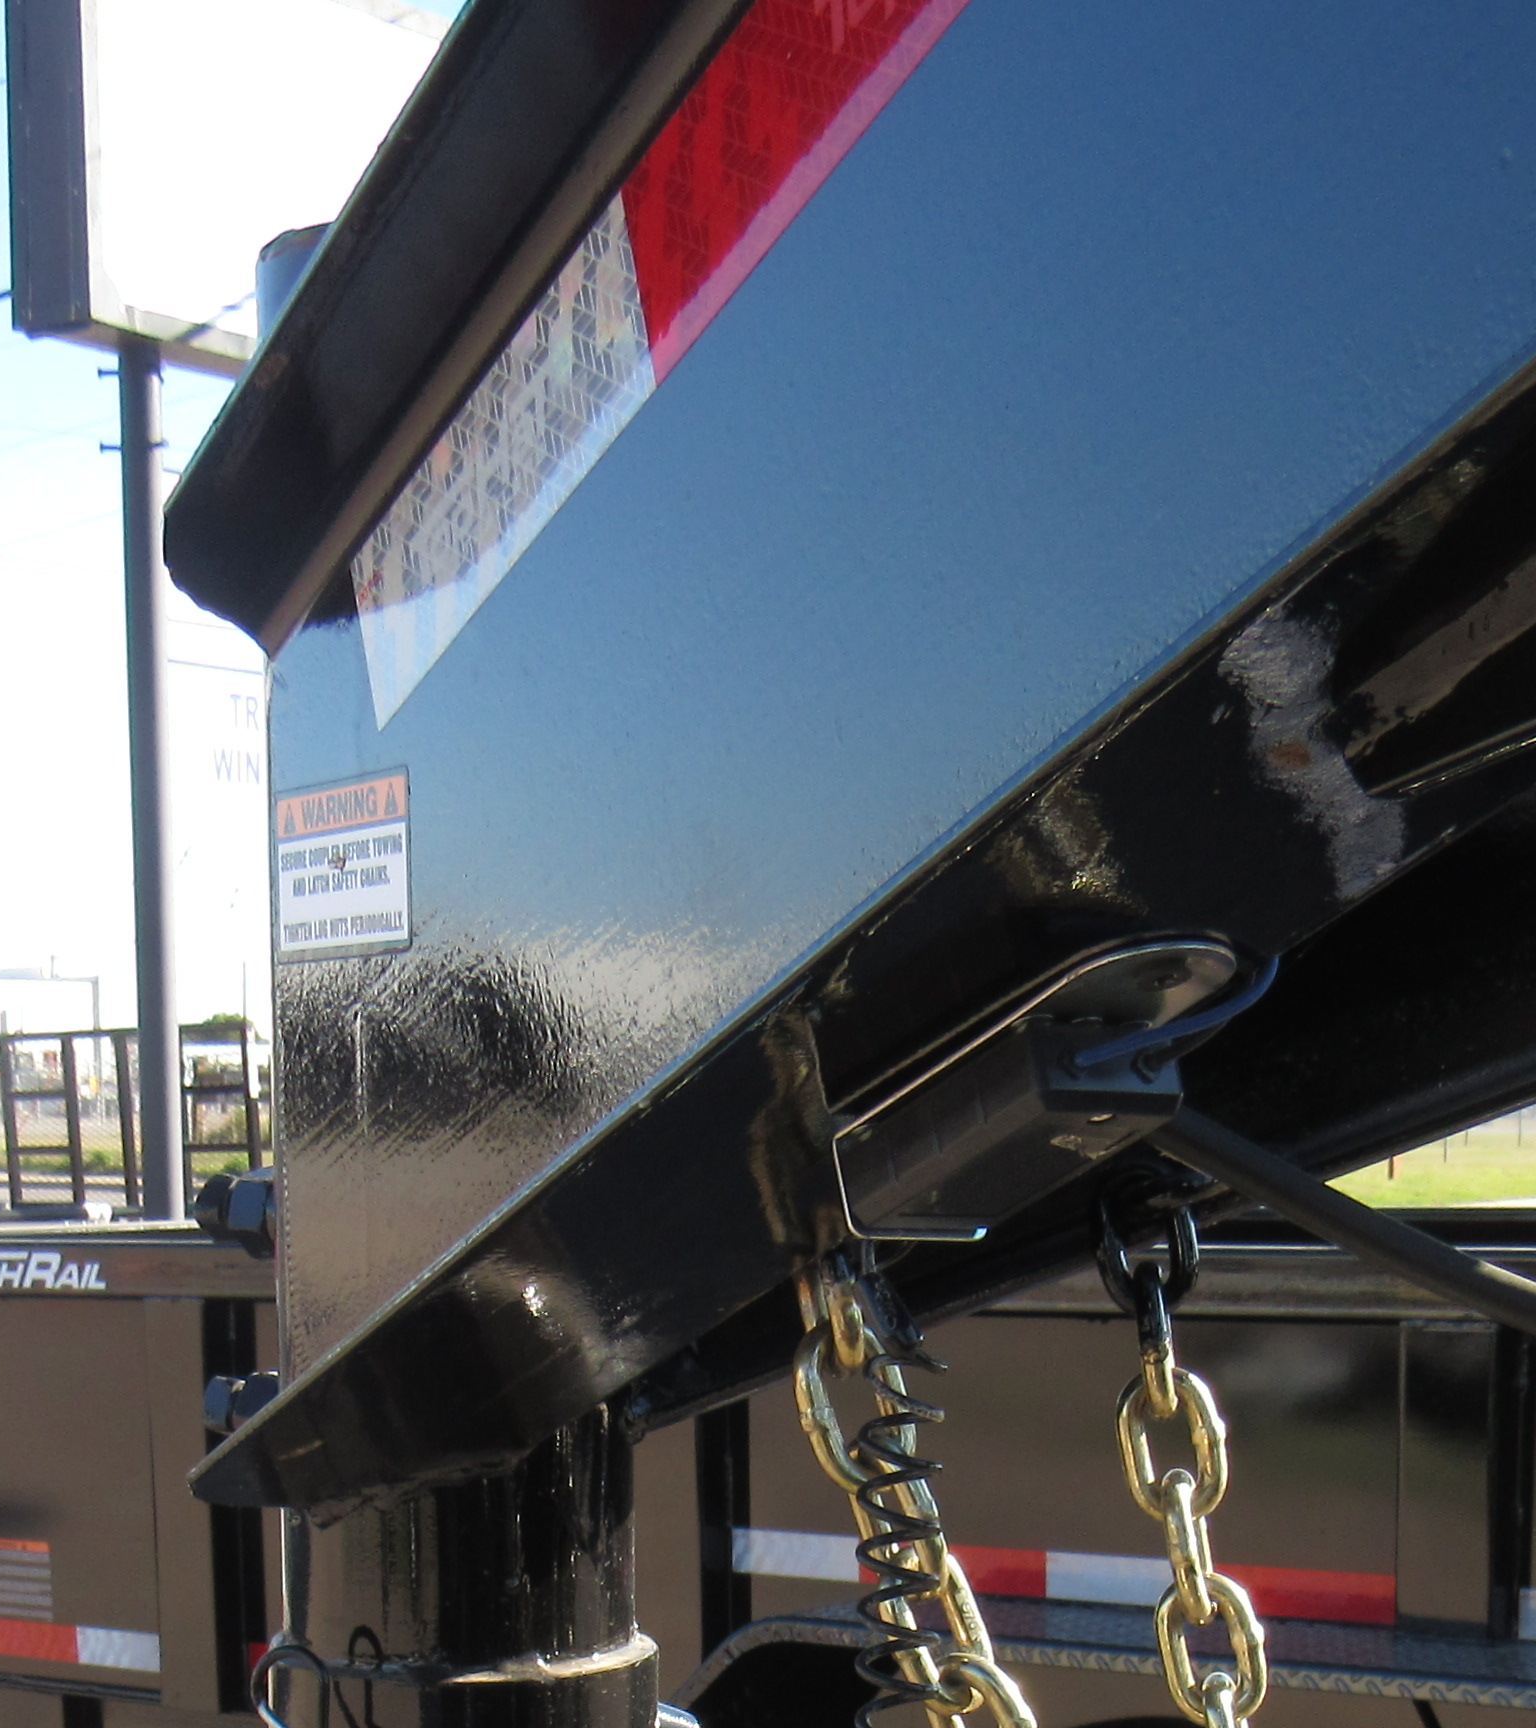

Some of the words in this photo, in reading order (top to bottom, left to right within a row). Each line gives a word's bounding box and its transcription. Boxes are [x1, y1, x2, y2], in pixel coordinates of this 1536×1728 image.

[301, 785, 378, 830] WARNING
[281, 849, 307, 872] SECURE
[372, 832, 403, 858] TOWING
[293, 876, 307, 898] AND
[332, 869, 359, 893] SAFETY
